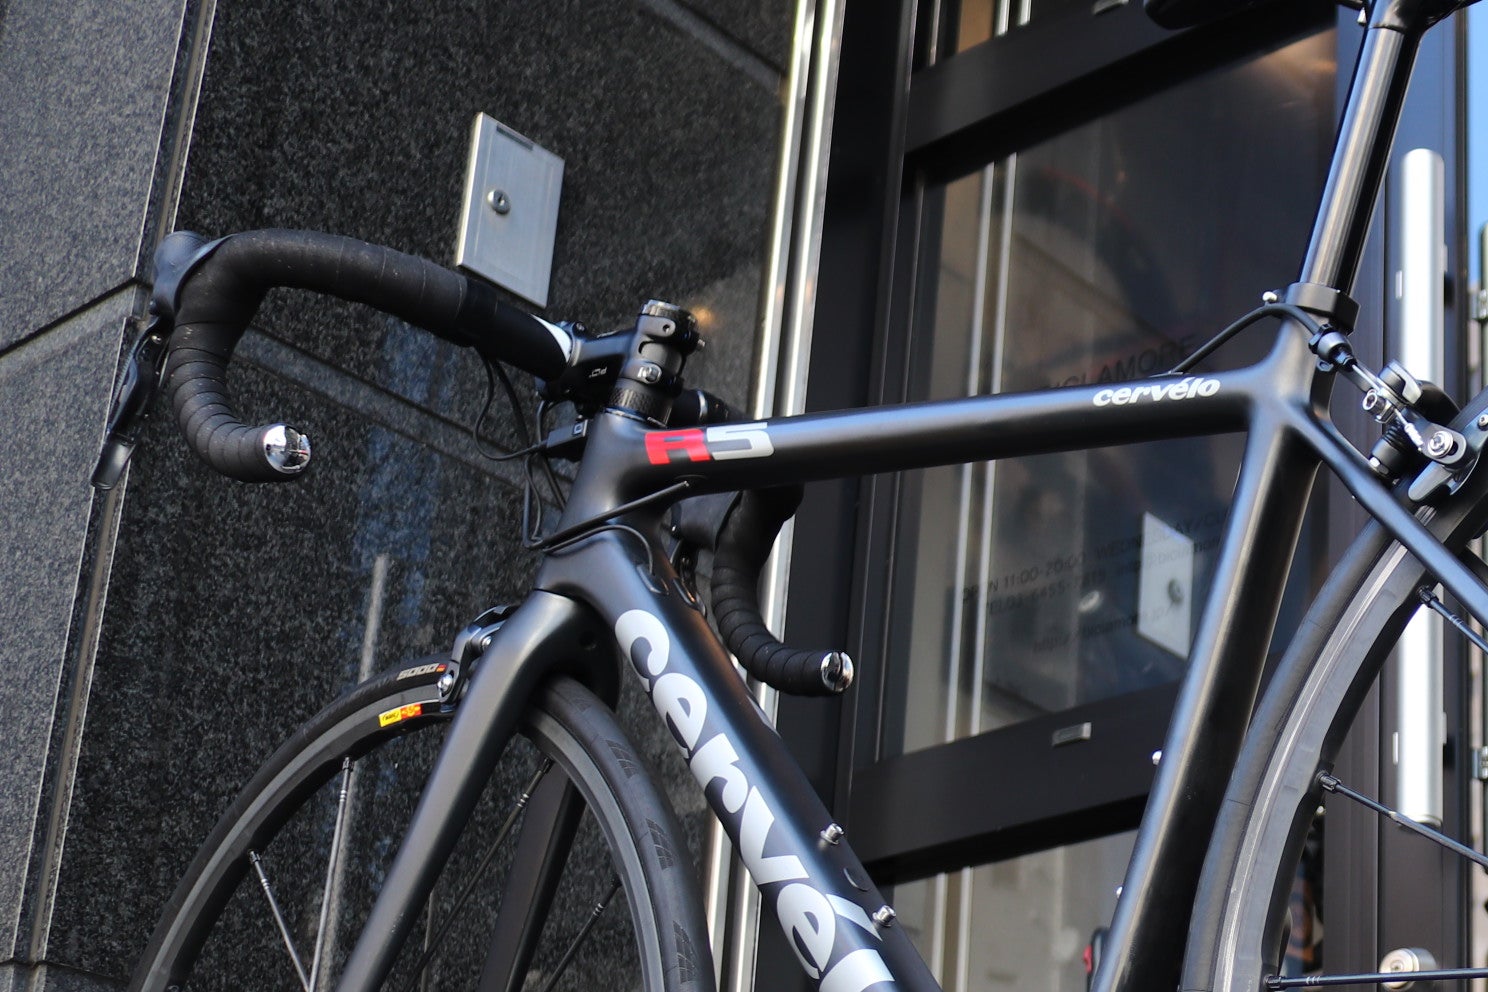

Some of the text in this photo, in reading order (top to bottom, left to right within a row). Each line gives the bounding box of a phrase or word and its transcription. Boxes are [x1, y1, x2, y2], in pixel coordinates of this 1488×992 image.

[1092, 376, 1221, 407] cervélo
[644, 421, 775, 465] R5
[396, 662, 440, 681] 5000
